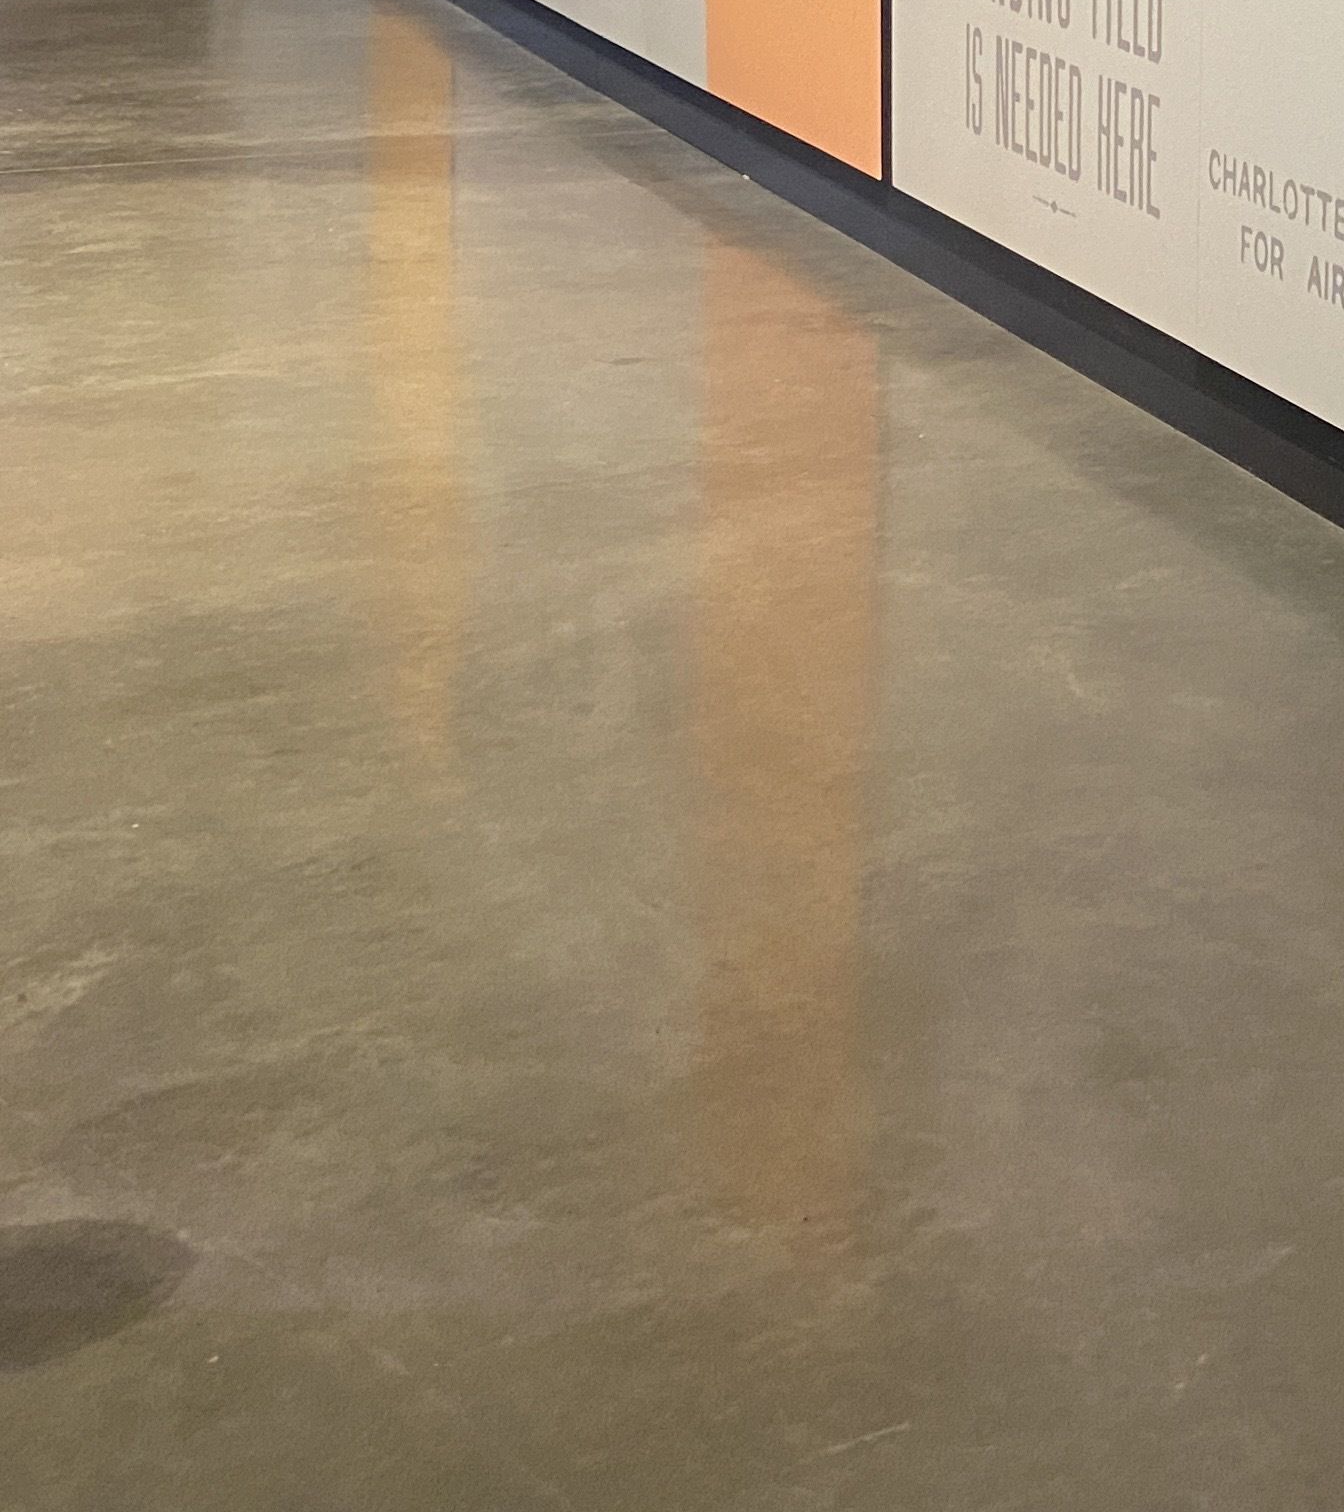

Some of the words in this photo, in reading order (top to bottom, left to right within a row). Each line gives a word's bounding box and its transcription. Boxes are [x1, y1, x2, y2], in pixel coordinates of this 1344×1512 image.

[965, 22, 983, 137] IS
[994, 34, 1083, 184] NEEDED
[1097, 74, 1161, 221] HERE
[1240, 224, 1285, 282] FOR
